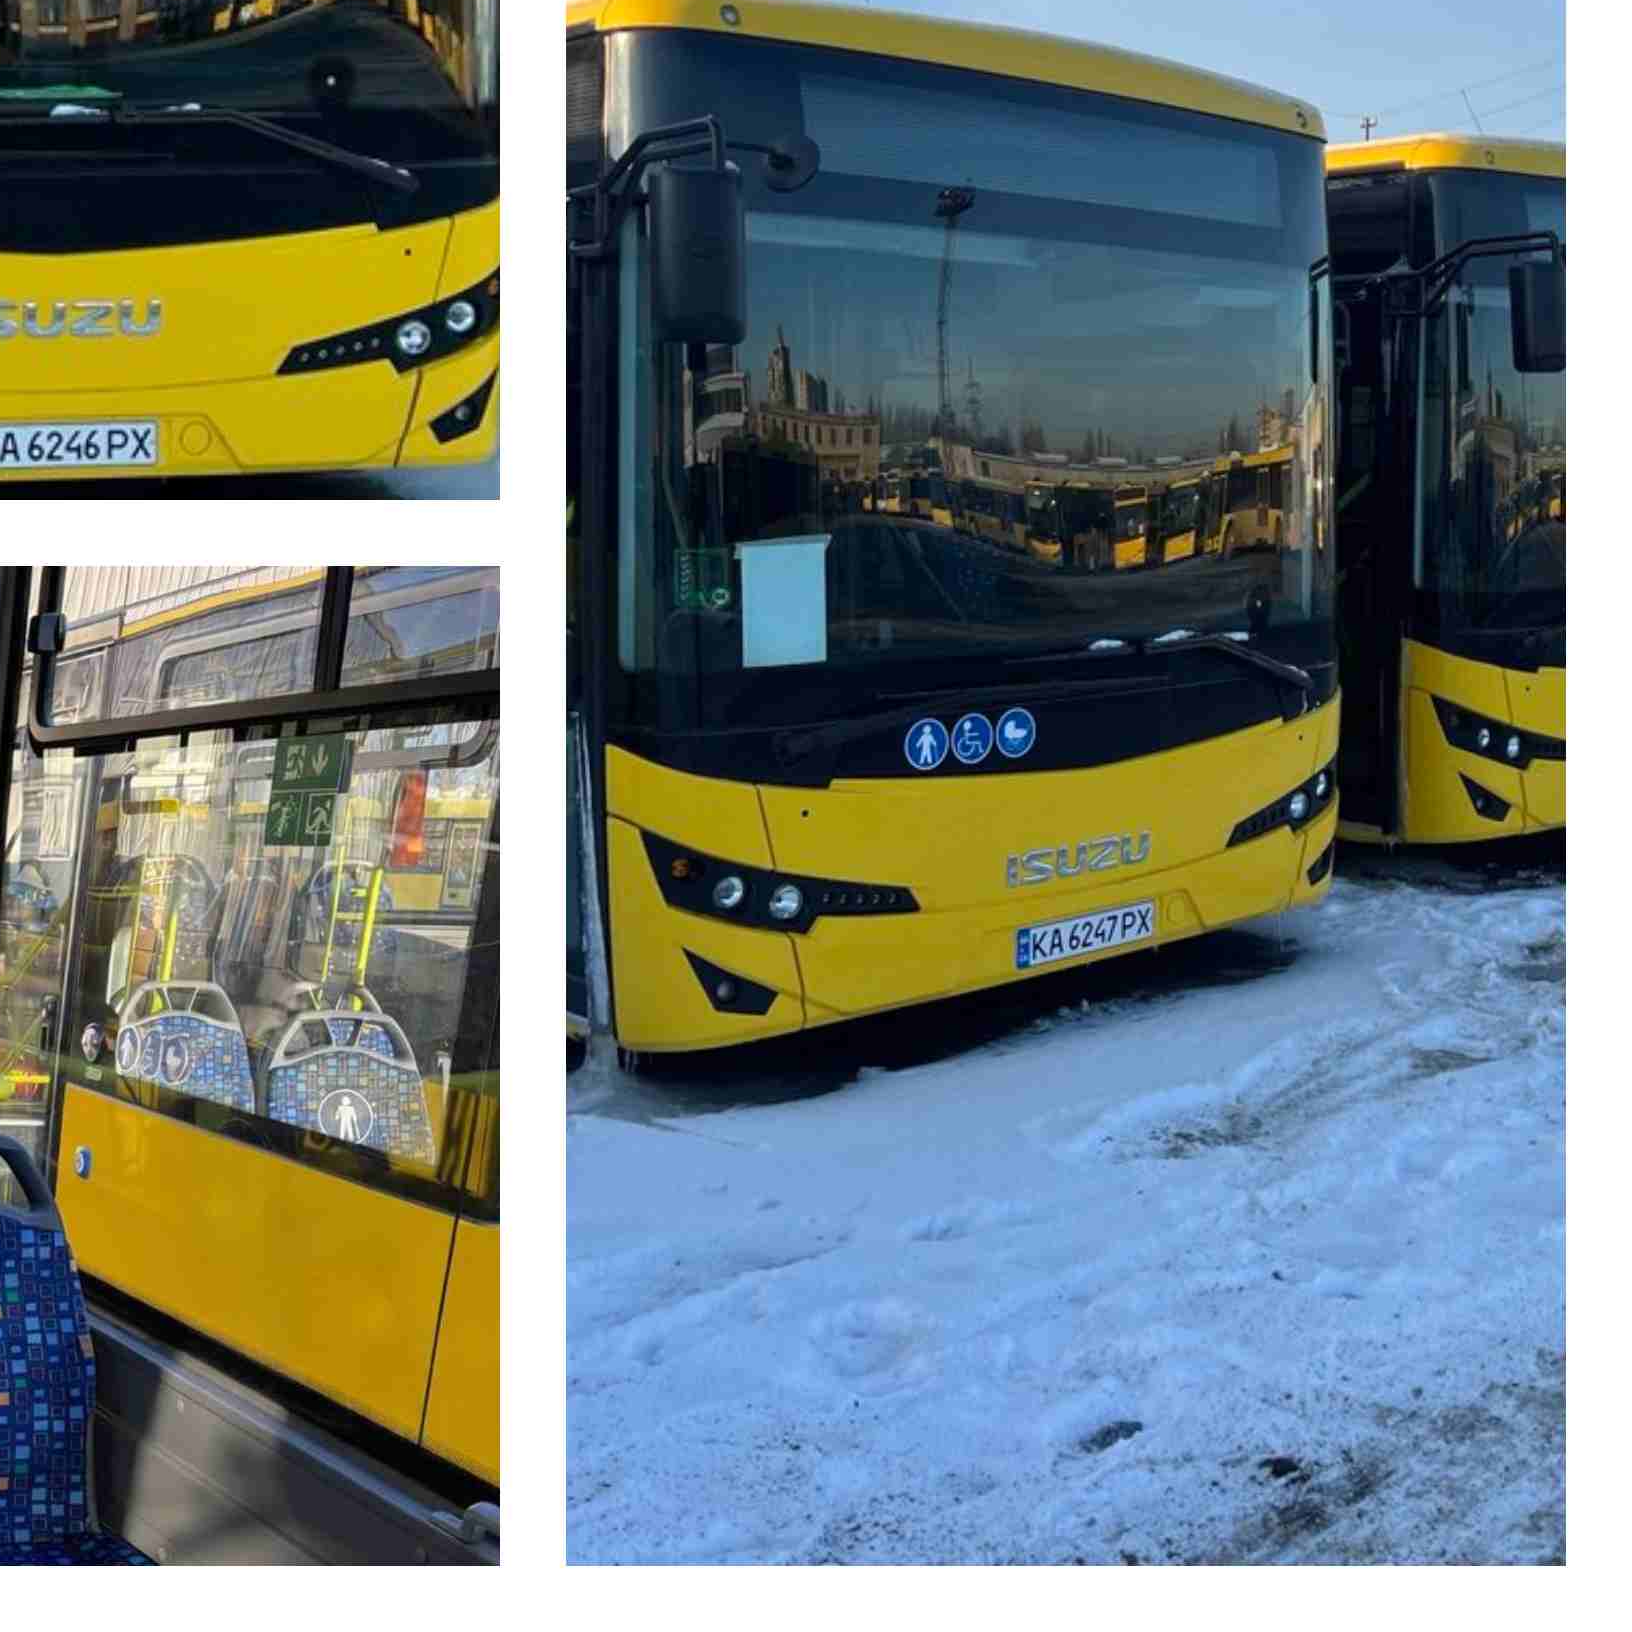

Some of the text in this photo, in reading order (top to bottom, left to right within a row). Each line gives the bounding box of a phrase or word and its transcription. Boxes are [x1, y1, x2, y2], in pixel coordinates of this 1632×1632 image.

[27, 429, 101, 462] 6246
[1006, 831, 1152, 889] ISUZU
[1068, 914, 1119, 951] 6247
